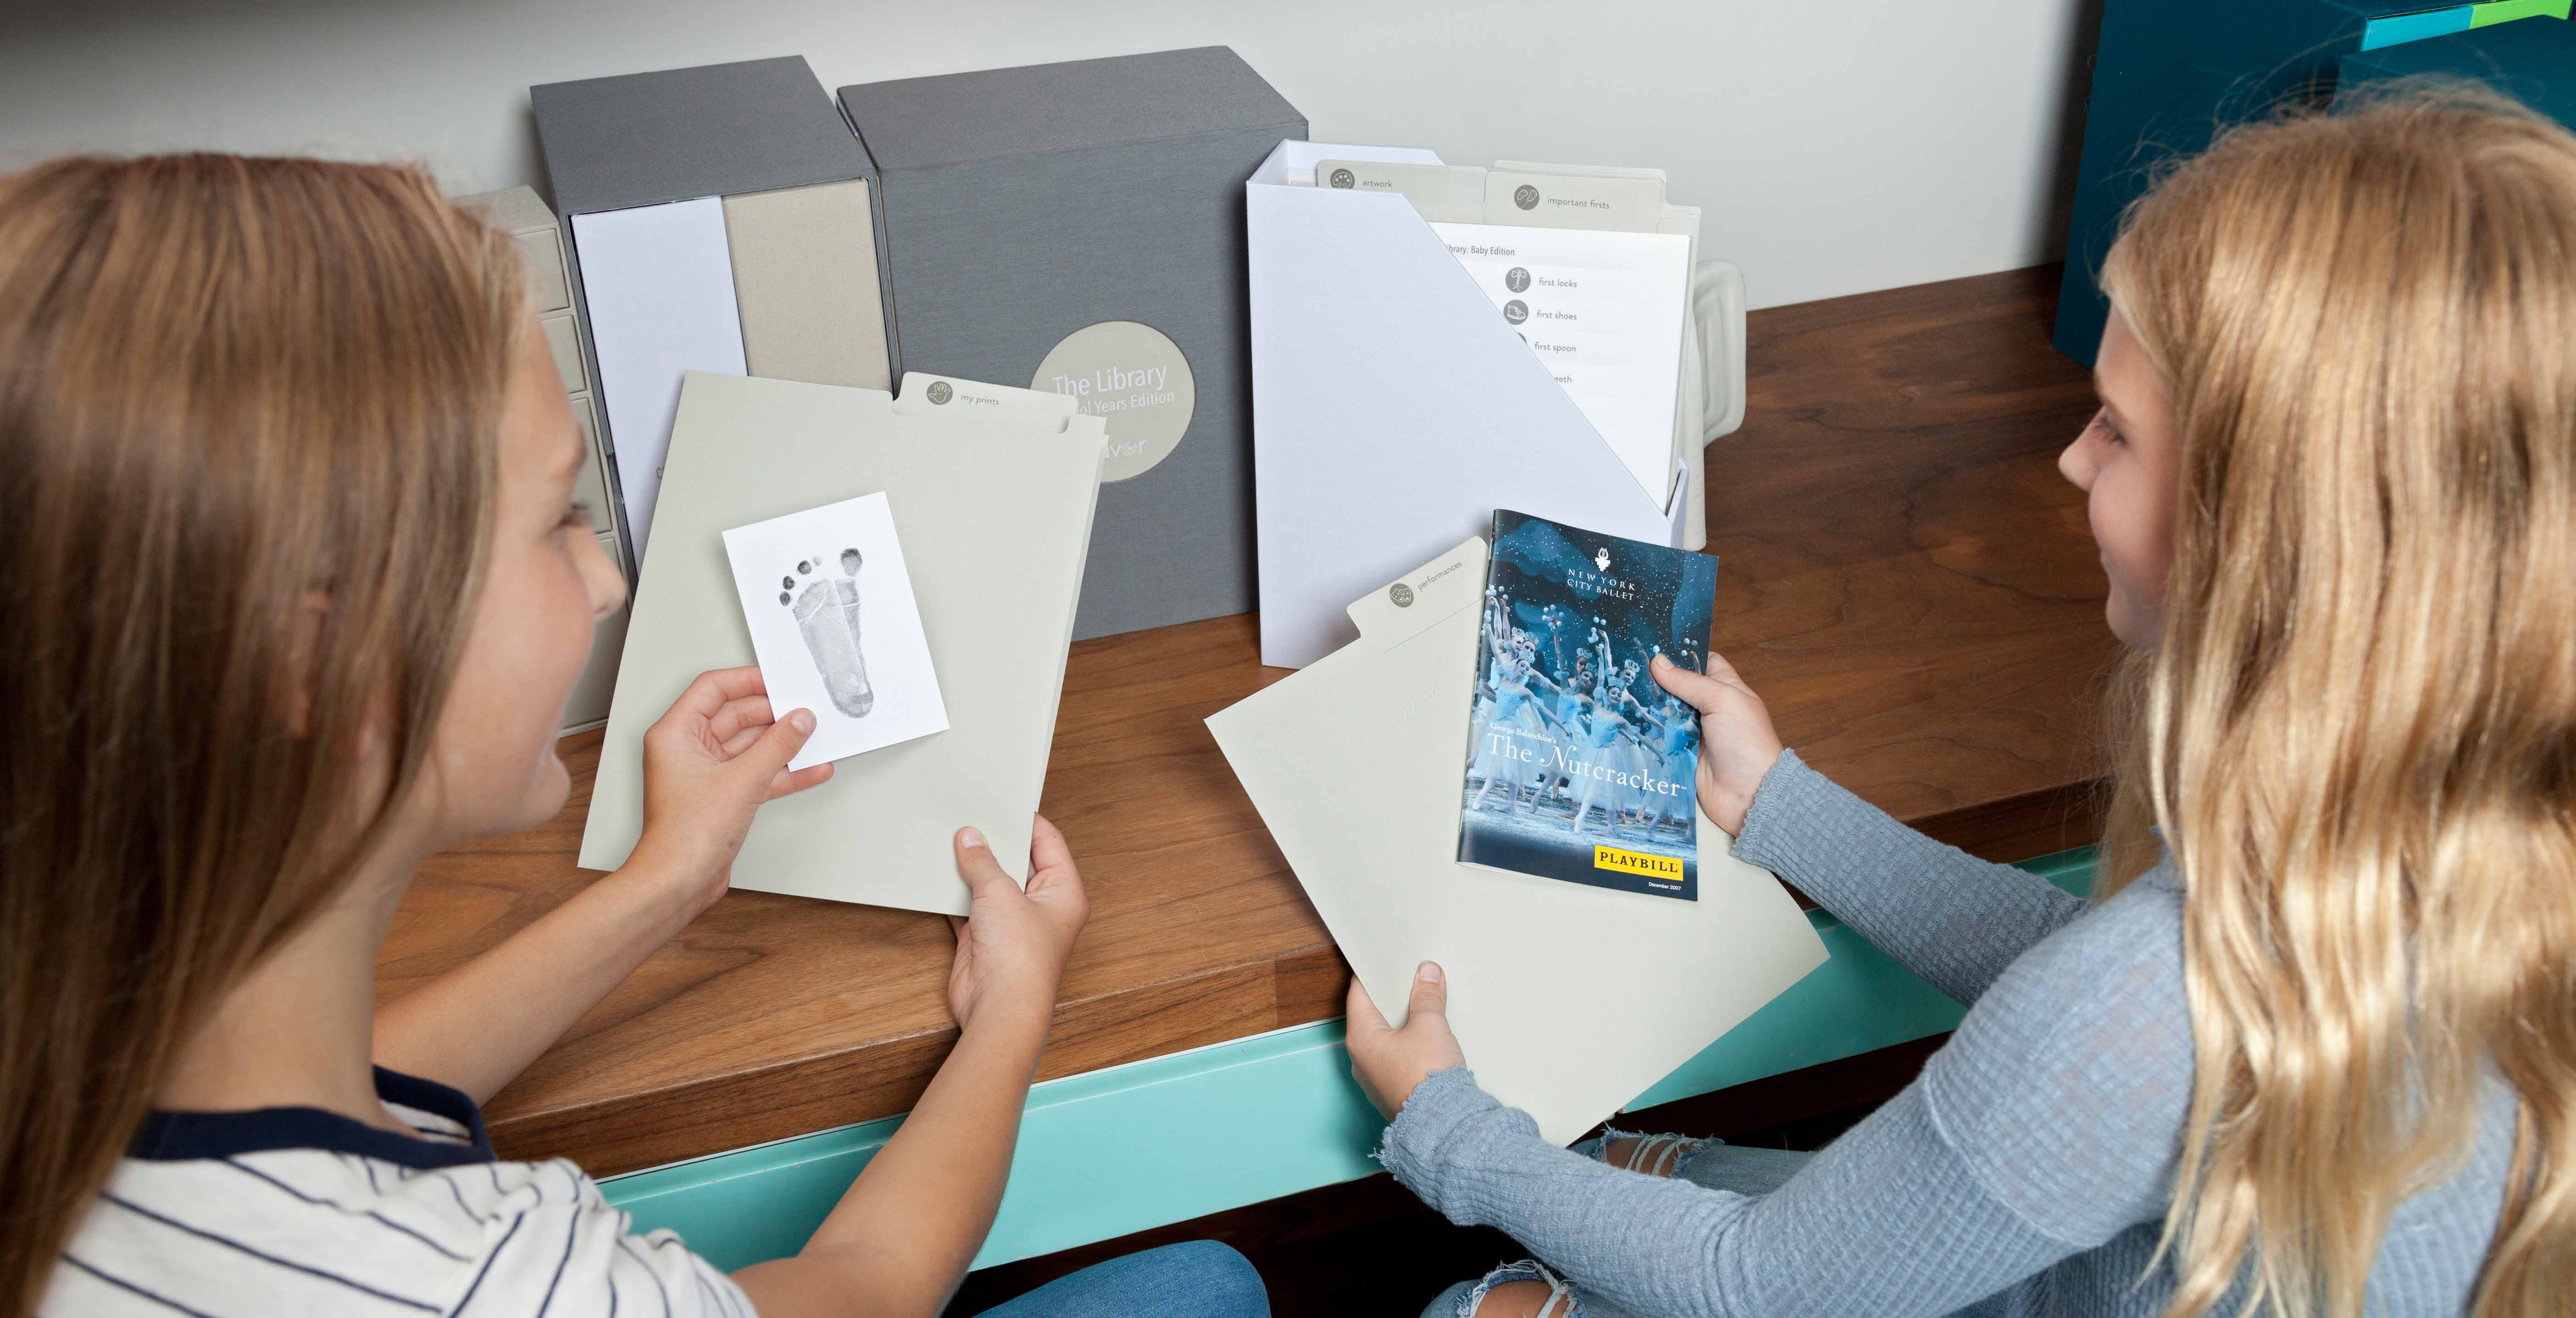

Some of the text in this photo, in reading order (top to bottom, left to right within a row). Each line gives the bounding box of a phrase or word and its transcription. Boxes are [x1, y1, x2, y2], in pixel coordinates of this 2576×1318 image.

[1547, 195, 1610, 209] important firsts
[1446, 243, 1515, 256] ibrary: Baby Edition
[1539, 277, 1577, 288] first locks
[1537, 310, 1577, 320] first shoes
[1534, 341, 1576, 354] first spoon
[1052, 366, 1167, 396] The Library
[1554, 375, 1572, 383] eeth
[961, 395, 999, 405] my prints
[1094, 398, 1127, 414] Years
[1130, 391, 1175, 408] Edition
[1417, 561, 1462, 592] performances
[1568, 568, 1635, 591] NEW YORK
[1567, 578, 1634, 601] CITY BALLET
[1489, 722, 1515, 734] George
[1487, 732, 1532, 763] The
[1599, 851, 1678, 873] PLAYBILL
[1648, 881, 1670, 890] December
